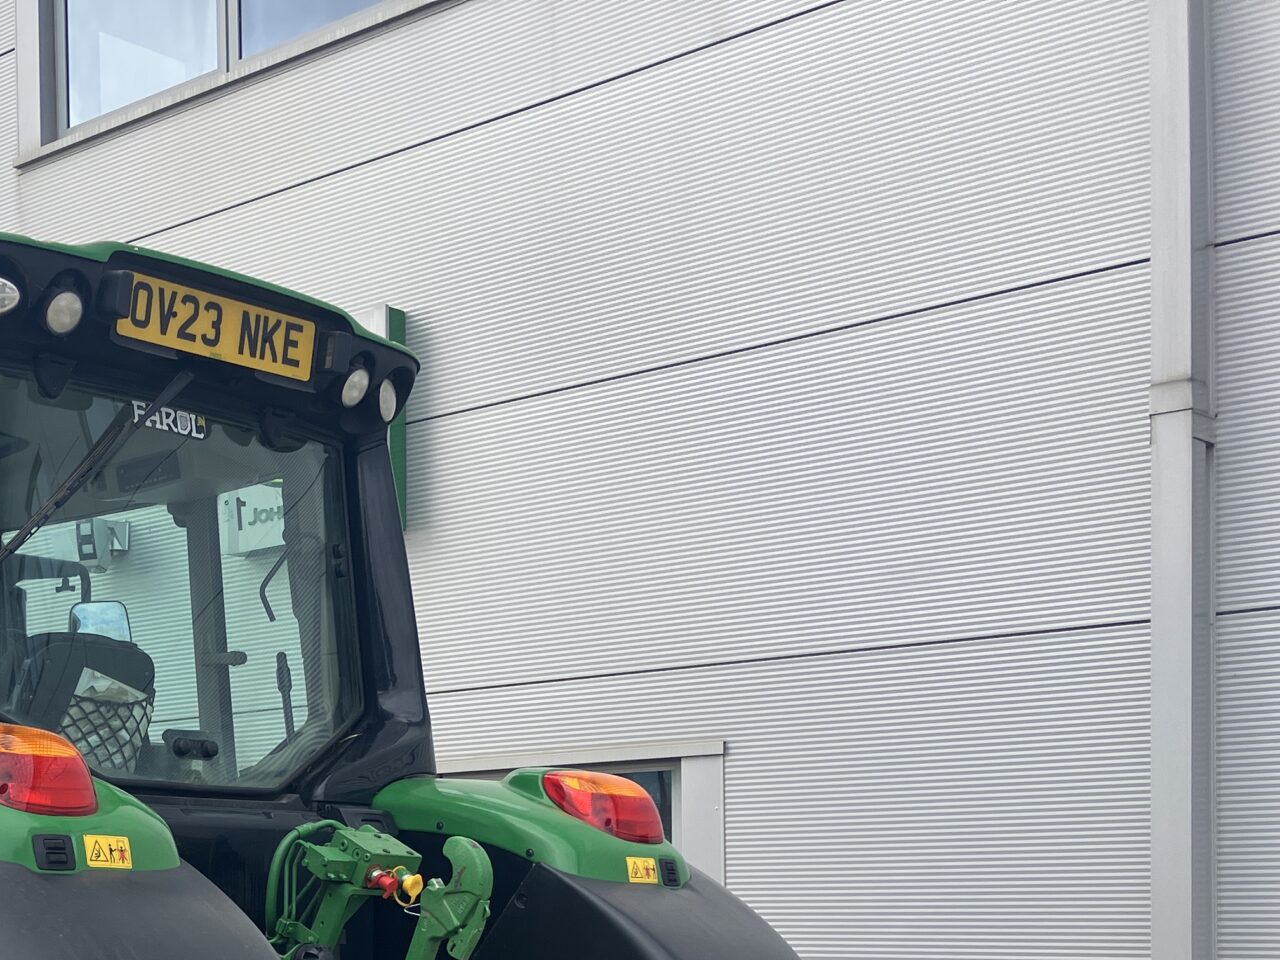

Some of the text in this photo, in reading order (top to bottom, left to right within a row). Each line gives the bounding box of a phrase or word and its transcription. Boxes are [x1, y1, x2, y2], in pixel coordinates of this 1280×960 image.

[130, 281, 304, 368] OV23 NKE
[131, 400, 205, 440] FAROL
